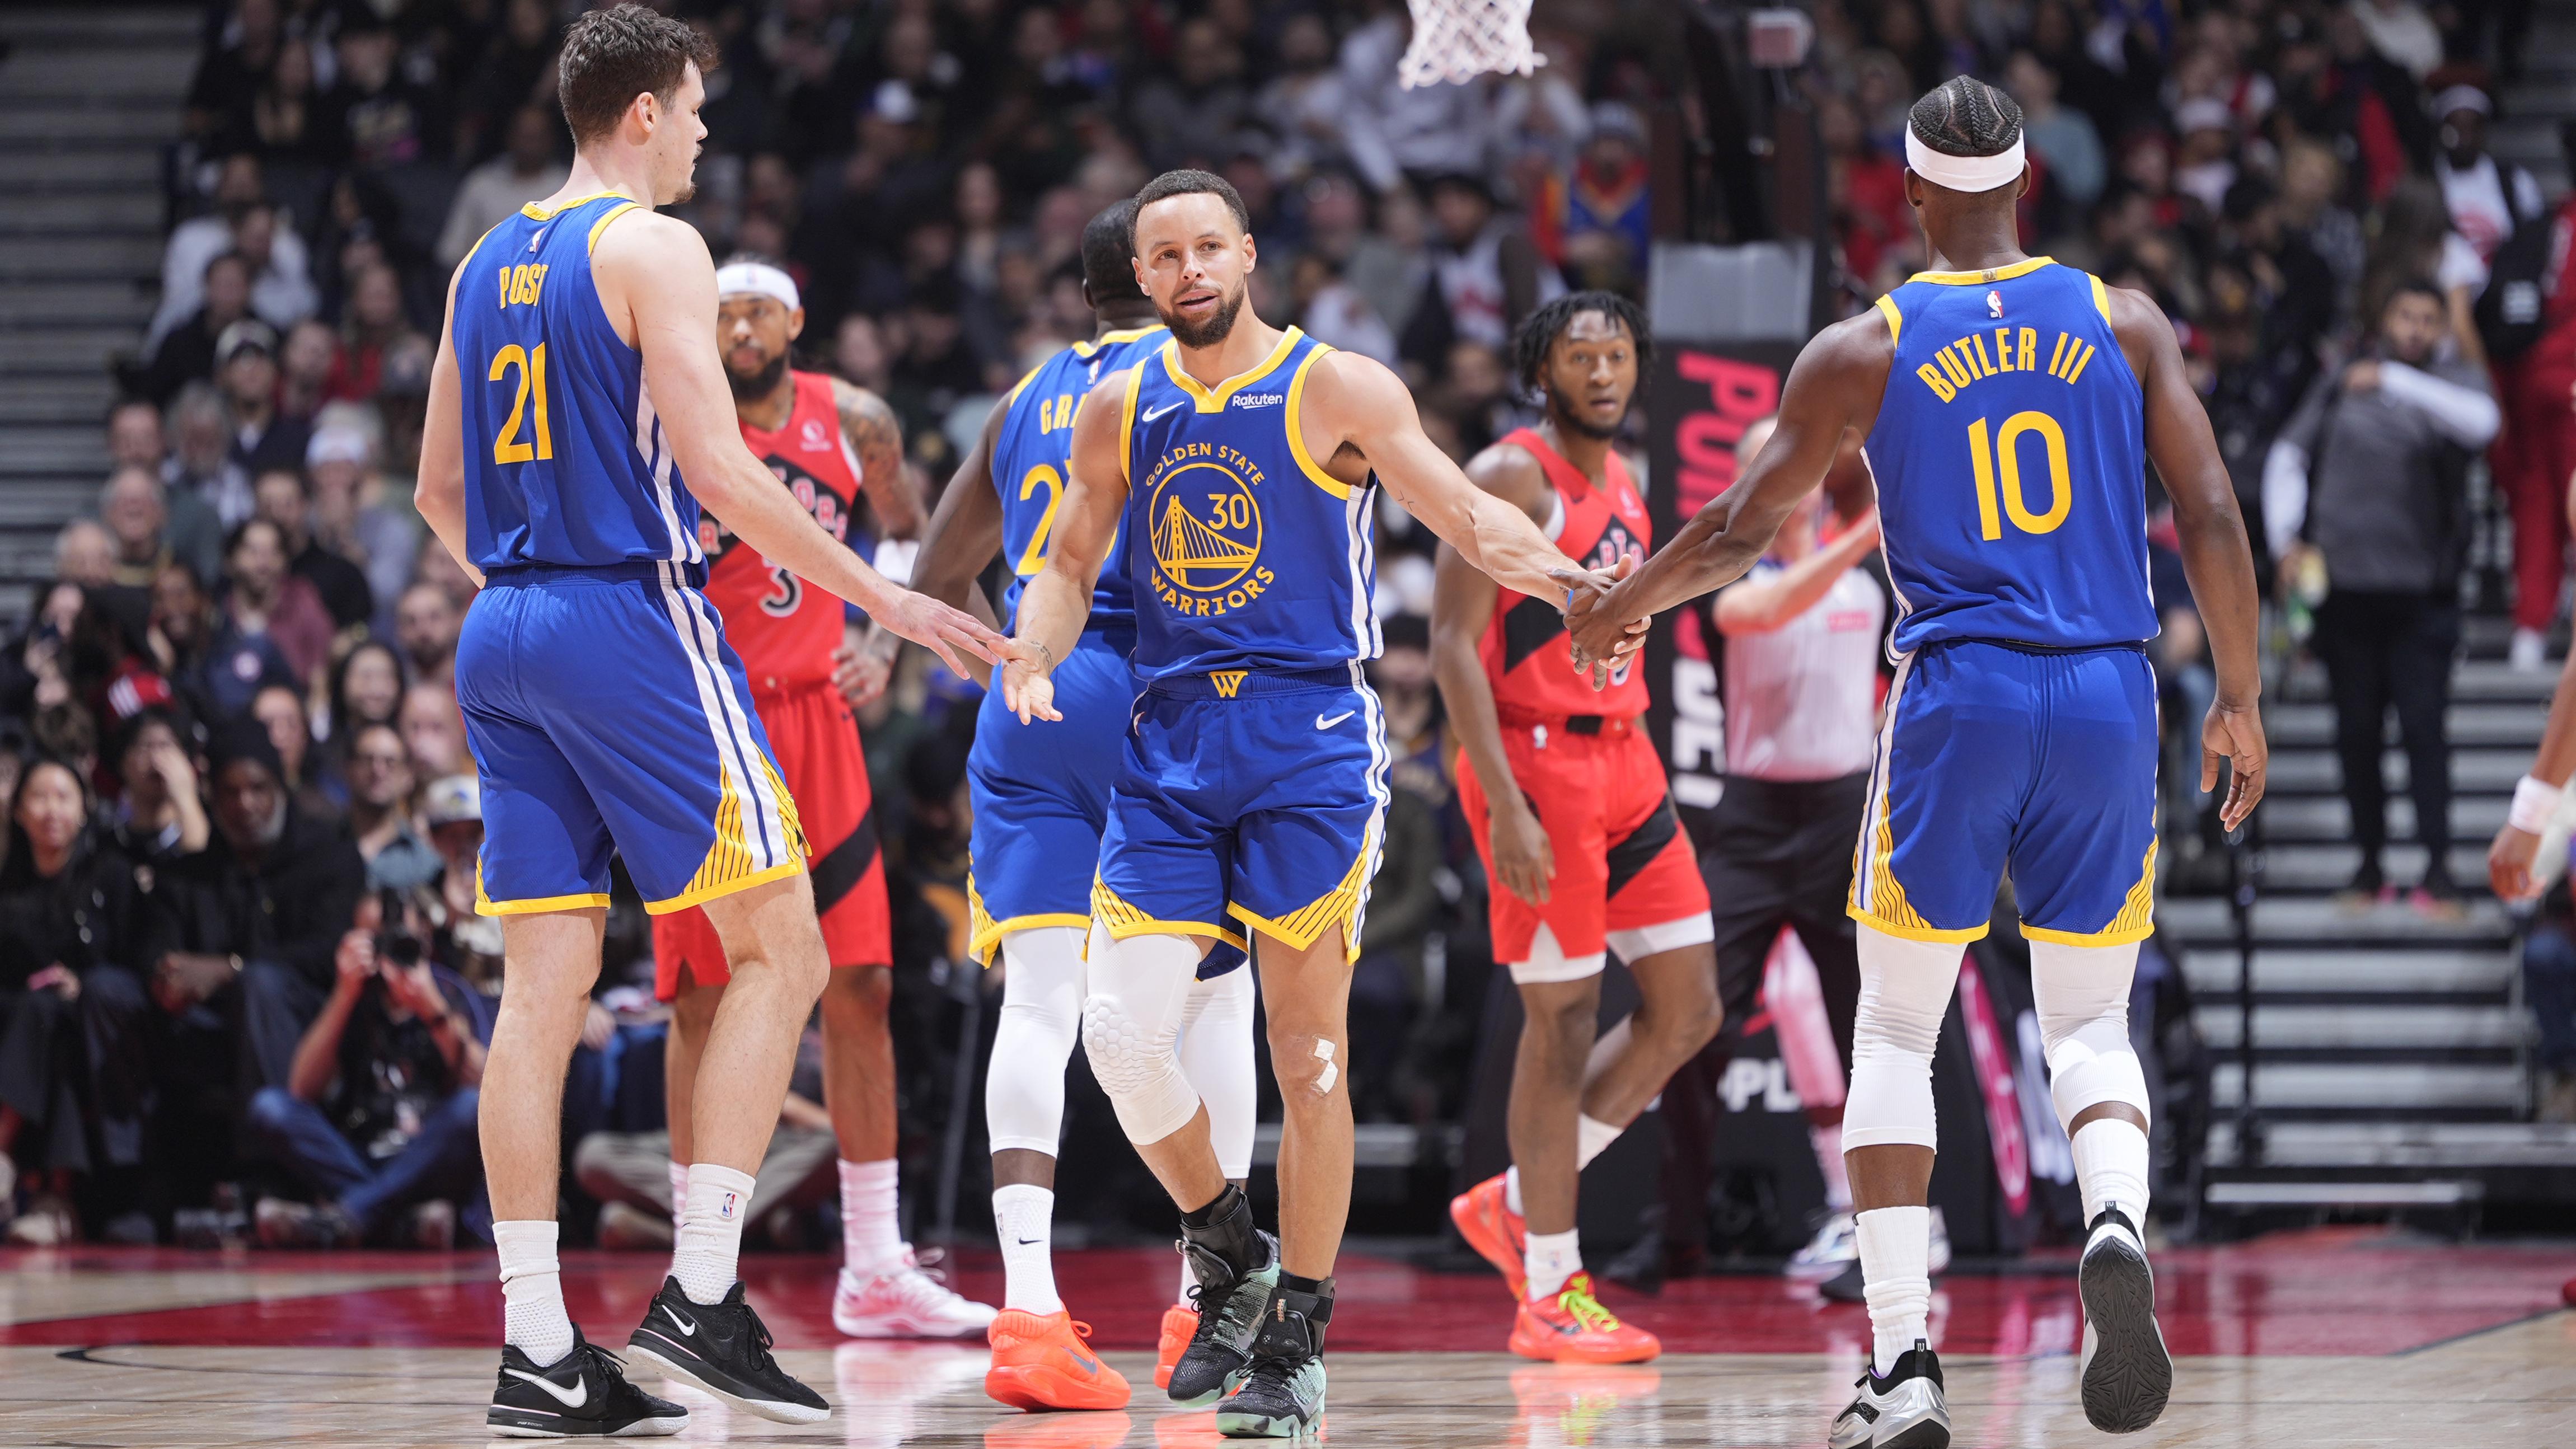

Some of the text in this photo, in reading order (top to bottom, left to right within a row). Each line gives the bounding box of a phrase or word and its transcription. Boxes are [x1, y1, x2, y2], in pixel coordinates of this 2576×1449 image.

[499, 264, 549, 310] POST
[1915, 327, 2095, 404] BUTLER III
[488, 341, 553, 465] 21
[1040, 393, 1088, 435] GR
[1233, 393, 1283, 409] Rakuten
[1146, 443, 1266, 486] GOLDEN STATE
[1968, 411, 2072, 541] 10
[1207, 494, 1250, 530] 30
[1151, 566, 1275, 616] WARRIORS
